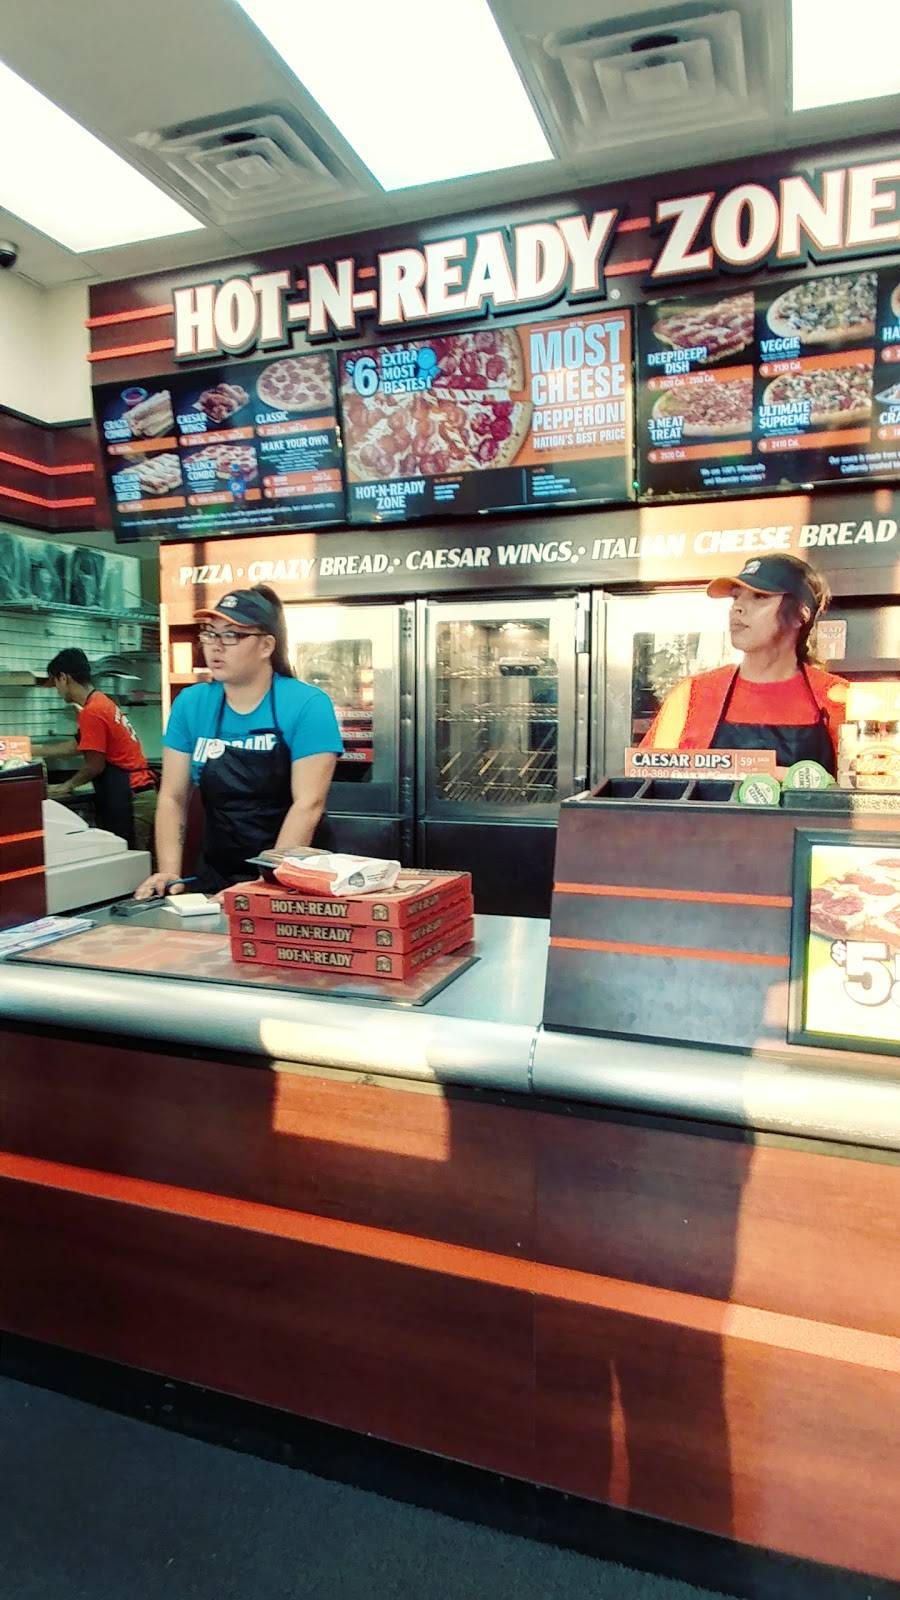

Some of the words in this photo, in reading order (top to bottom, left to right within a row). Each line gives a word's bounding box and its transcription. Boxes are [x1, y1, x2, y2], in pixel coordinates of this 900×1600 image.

[172, 208, 618, 358] HOT-N-READY
[654, 163, 900, 277] ZONE
[530, 321, 625, 374] MOST
[760, 336, 801, 353] VEGGIE
[381, 350, 418, 367] EXTRA
[647, 346, 708, 366] DEEP!DEEP!
[345, 356, 380, 397] $6
[382, 364, 416, 381] MOST
[665, 361, 690, 375] DISH
[531, 364, 625, 406] CHEESE
[255, 411, 289, 424] CLASSIC
[532, 401, 625, 432] PEPPERONI
[759, 400, 811, 418] ULTIMATE
[176, 412, 207, 425] CAESAR
[647, 419, 656, 430] 3
[656, 416, 684, 429] MEAT
[759, 412, 810, 429] SUPREME
[180, 422, 207, 434] WINGS
[650, 427, 682, 441] TREAT
[260, 439, 285, 452] MAKE
[286, 437, 308, 449] YOUR
[308, 435, 329, 447] OWN
[533, 432, 574, 449] NATION'S
[575, 430, 597, 444] BEST
[599, 427, 625, 441] PRICE
[187, 470, 216, 481] COMBO
[355, 480, 425, 499] HOT-N-READY
[376, 496, 406, 510] ZONE
[178, 563, 233, 586] PIZZA
[247, 558, 313, 582] CRAZY
[406, 546, 491, 571] CAESAR
[592, 533, 686, 559] ITALIAN
[693, 526, 794, 554] CHEESE
[798, 519, 898, 548] BREAD
[631, 753, 690, 767] CAESAR
[694, 754, 731, 768] DIPS
[270, 900, 350, 918] HOT-N-READY
[275, 923, 353, 943] HOT-N-READY
[277, 947, 353, 968] HOT-N-READY
